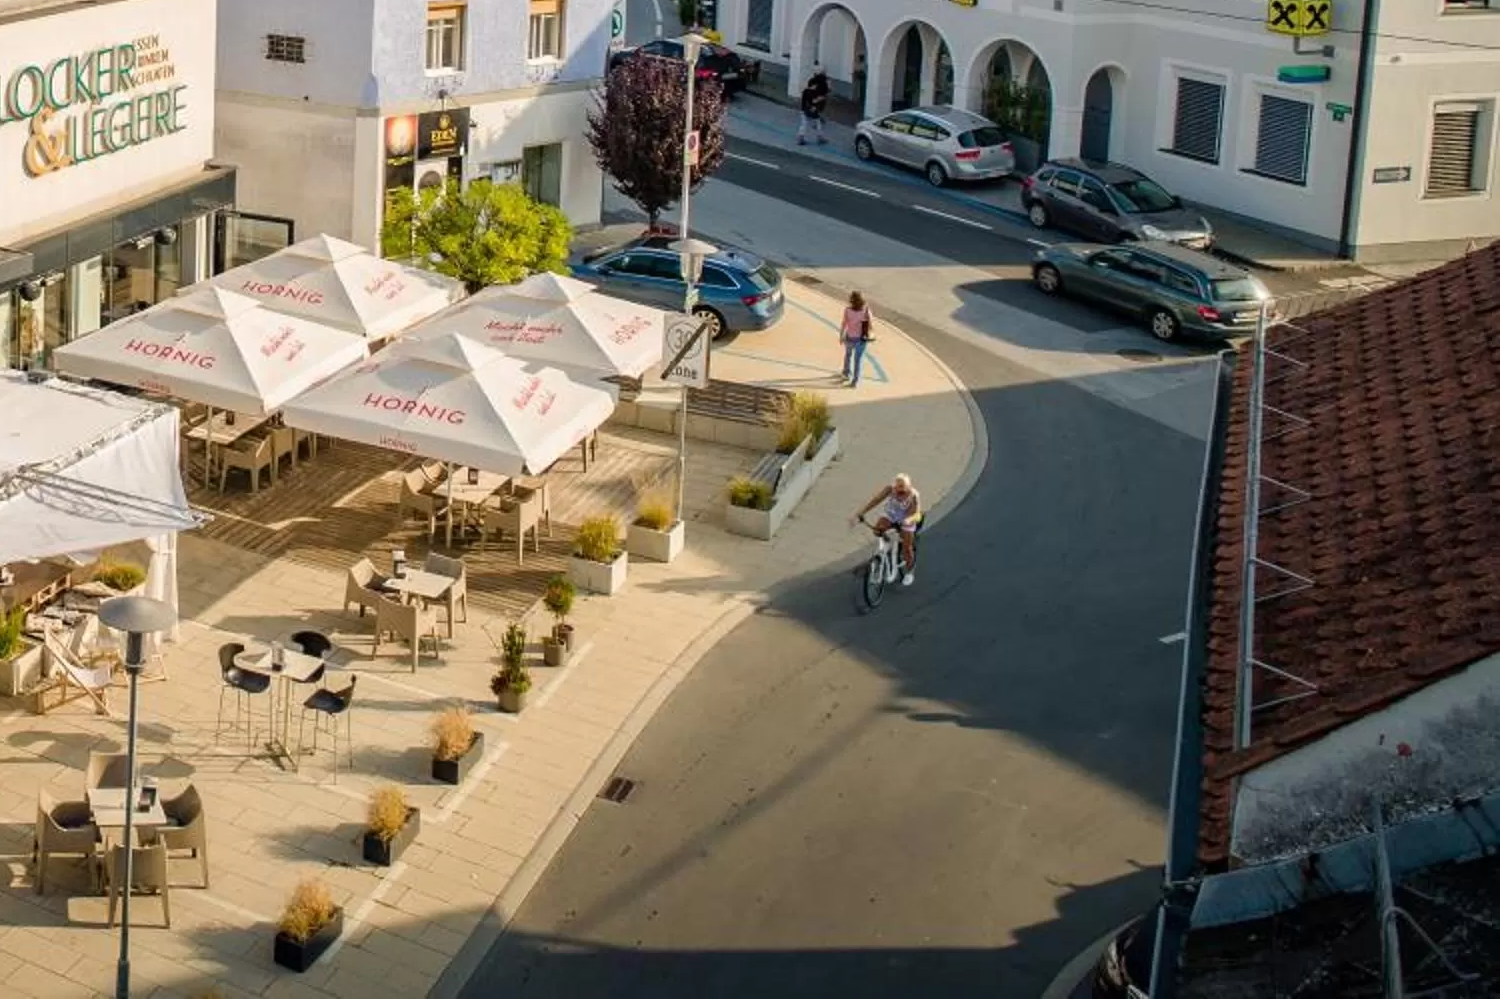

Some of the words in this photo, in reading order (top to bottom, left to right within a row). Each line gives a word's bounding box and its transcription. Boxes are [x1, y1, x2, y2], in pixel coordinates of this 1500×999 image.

[66, 84, 188, 165] LEGERE
[242, 280, 324, 305] HORNIG
[124, 338, 216, 369] HORNIG
[363, 392, 467, 424] HORNIG
